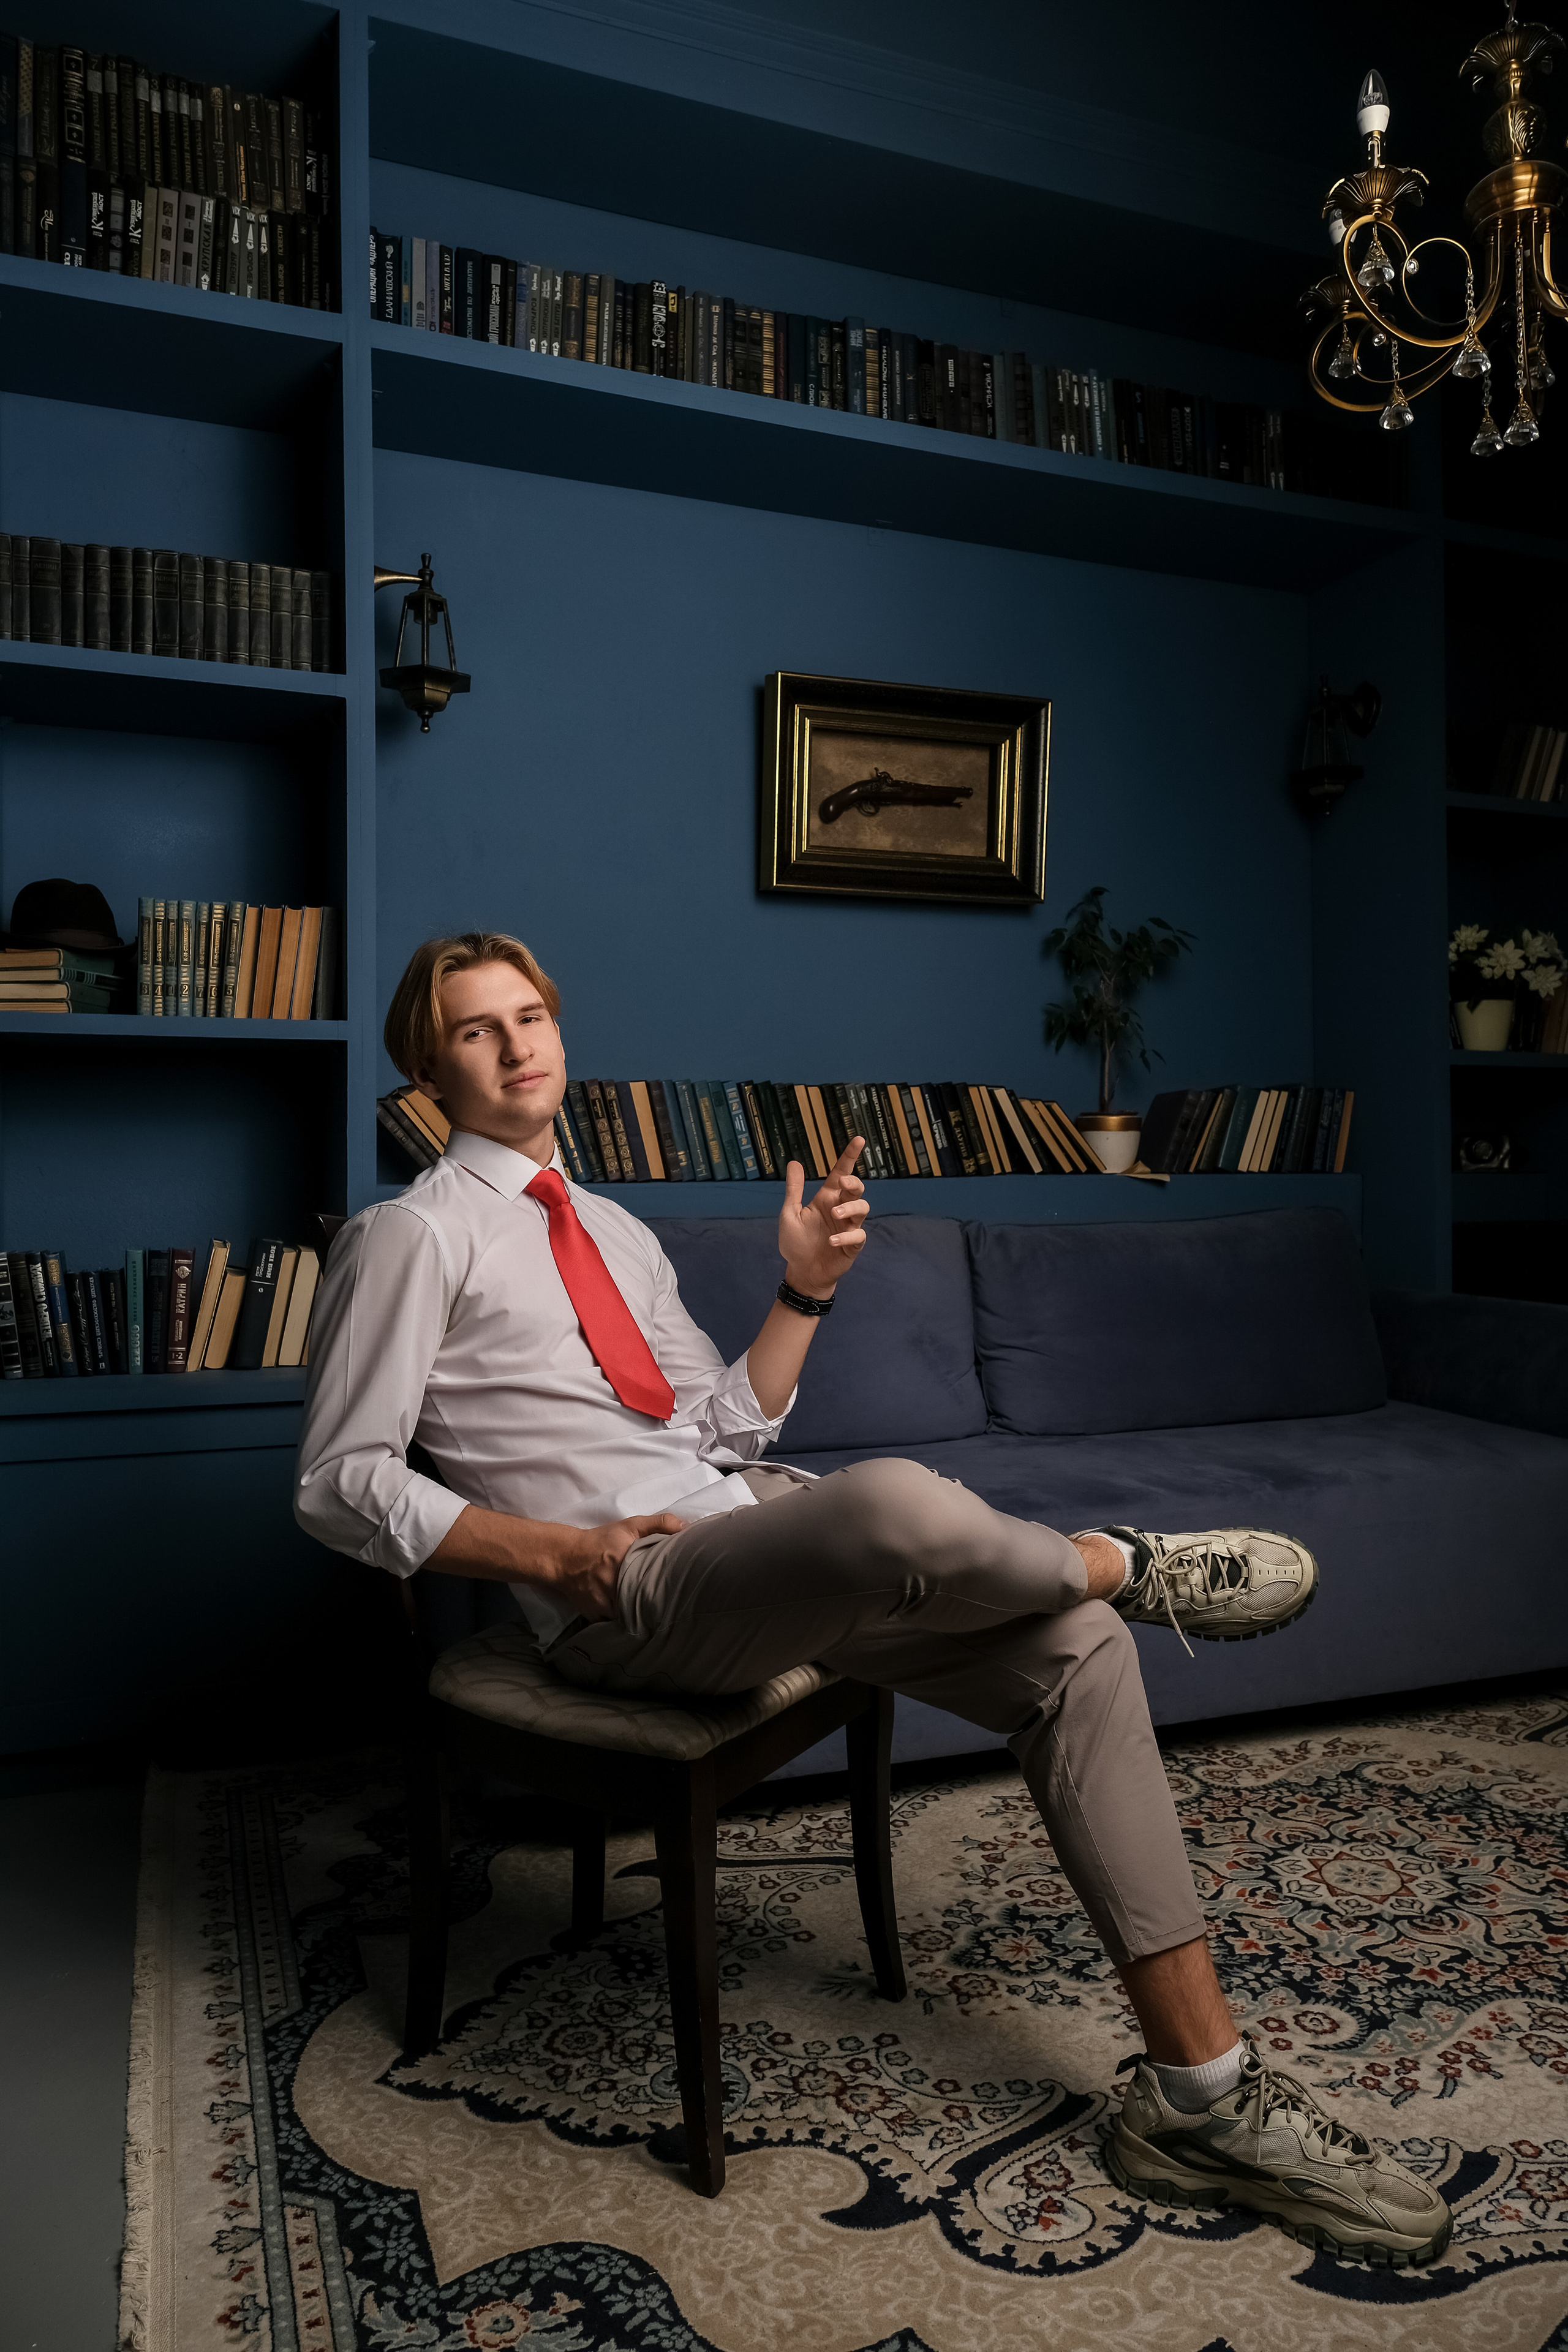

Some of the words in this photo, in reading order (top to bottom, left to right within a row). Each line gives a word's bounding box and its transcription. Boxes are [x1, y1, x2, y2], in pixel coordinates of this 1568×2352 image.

[201, 224, 211, 272] КРУПСКАЯ
[467, 296, 473, 305] ПО
[489, 304, 500, 333] ГРОССМАН
[143, 984, 148, 994] 3
[154, 986, 161, 995] 4
[182, 984, 189, 995] 2
[198, 987, 204, 997] 7
[211, 986, 217, 997] 6
[227, 986, 233, 995] 5
[881, 1117, 890, 1148] ПОВЕСТИ
[956, 1128, 968, 1156] ДАУРИЯ
[709, 1140, 720, 1164] ВОЙНА
[29, 1262, 46, 1302] СТОЙКИХ
[175, 1283, 187, 1314] КАТРИН
[36, 1303, 52, 1341] ЧЕТВЕРО
[92, 1300, 100, 1336] ФИЛОСОФСКИЙ
